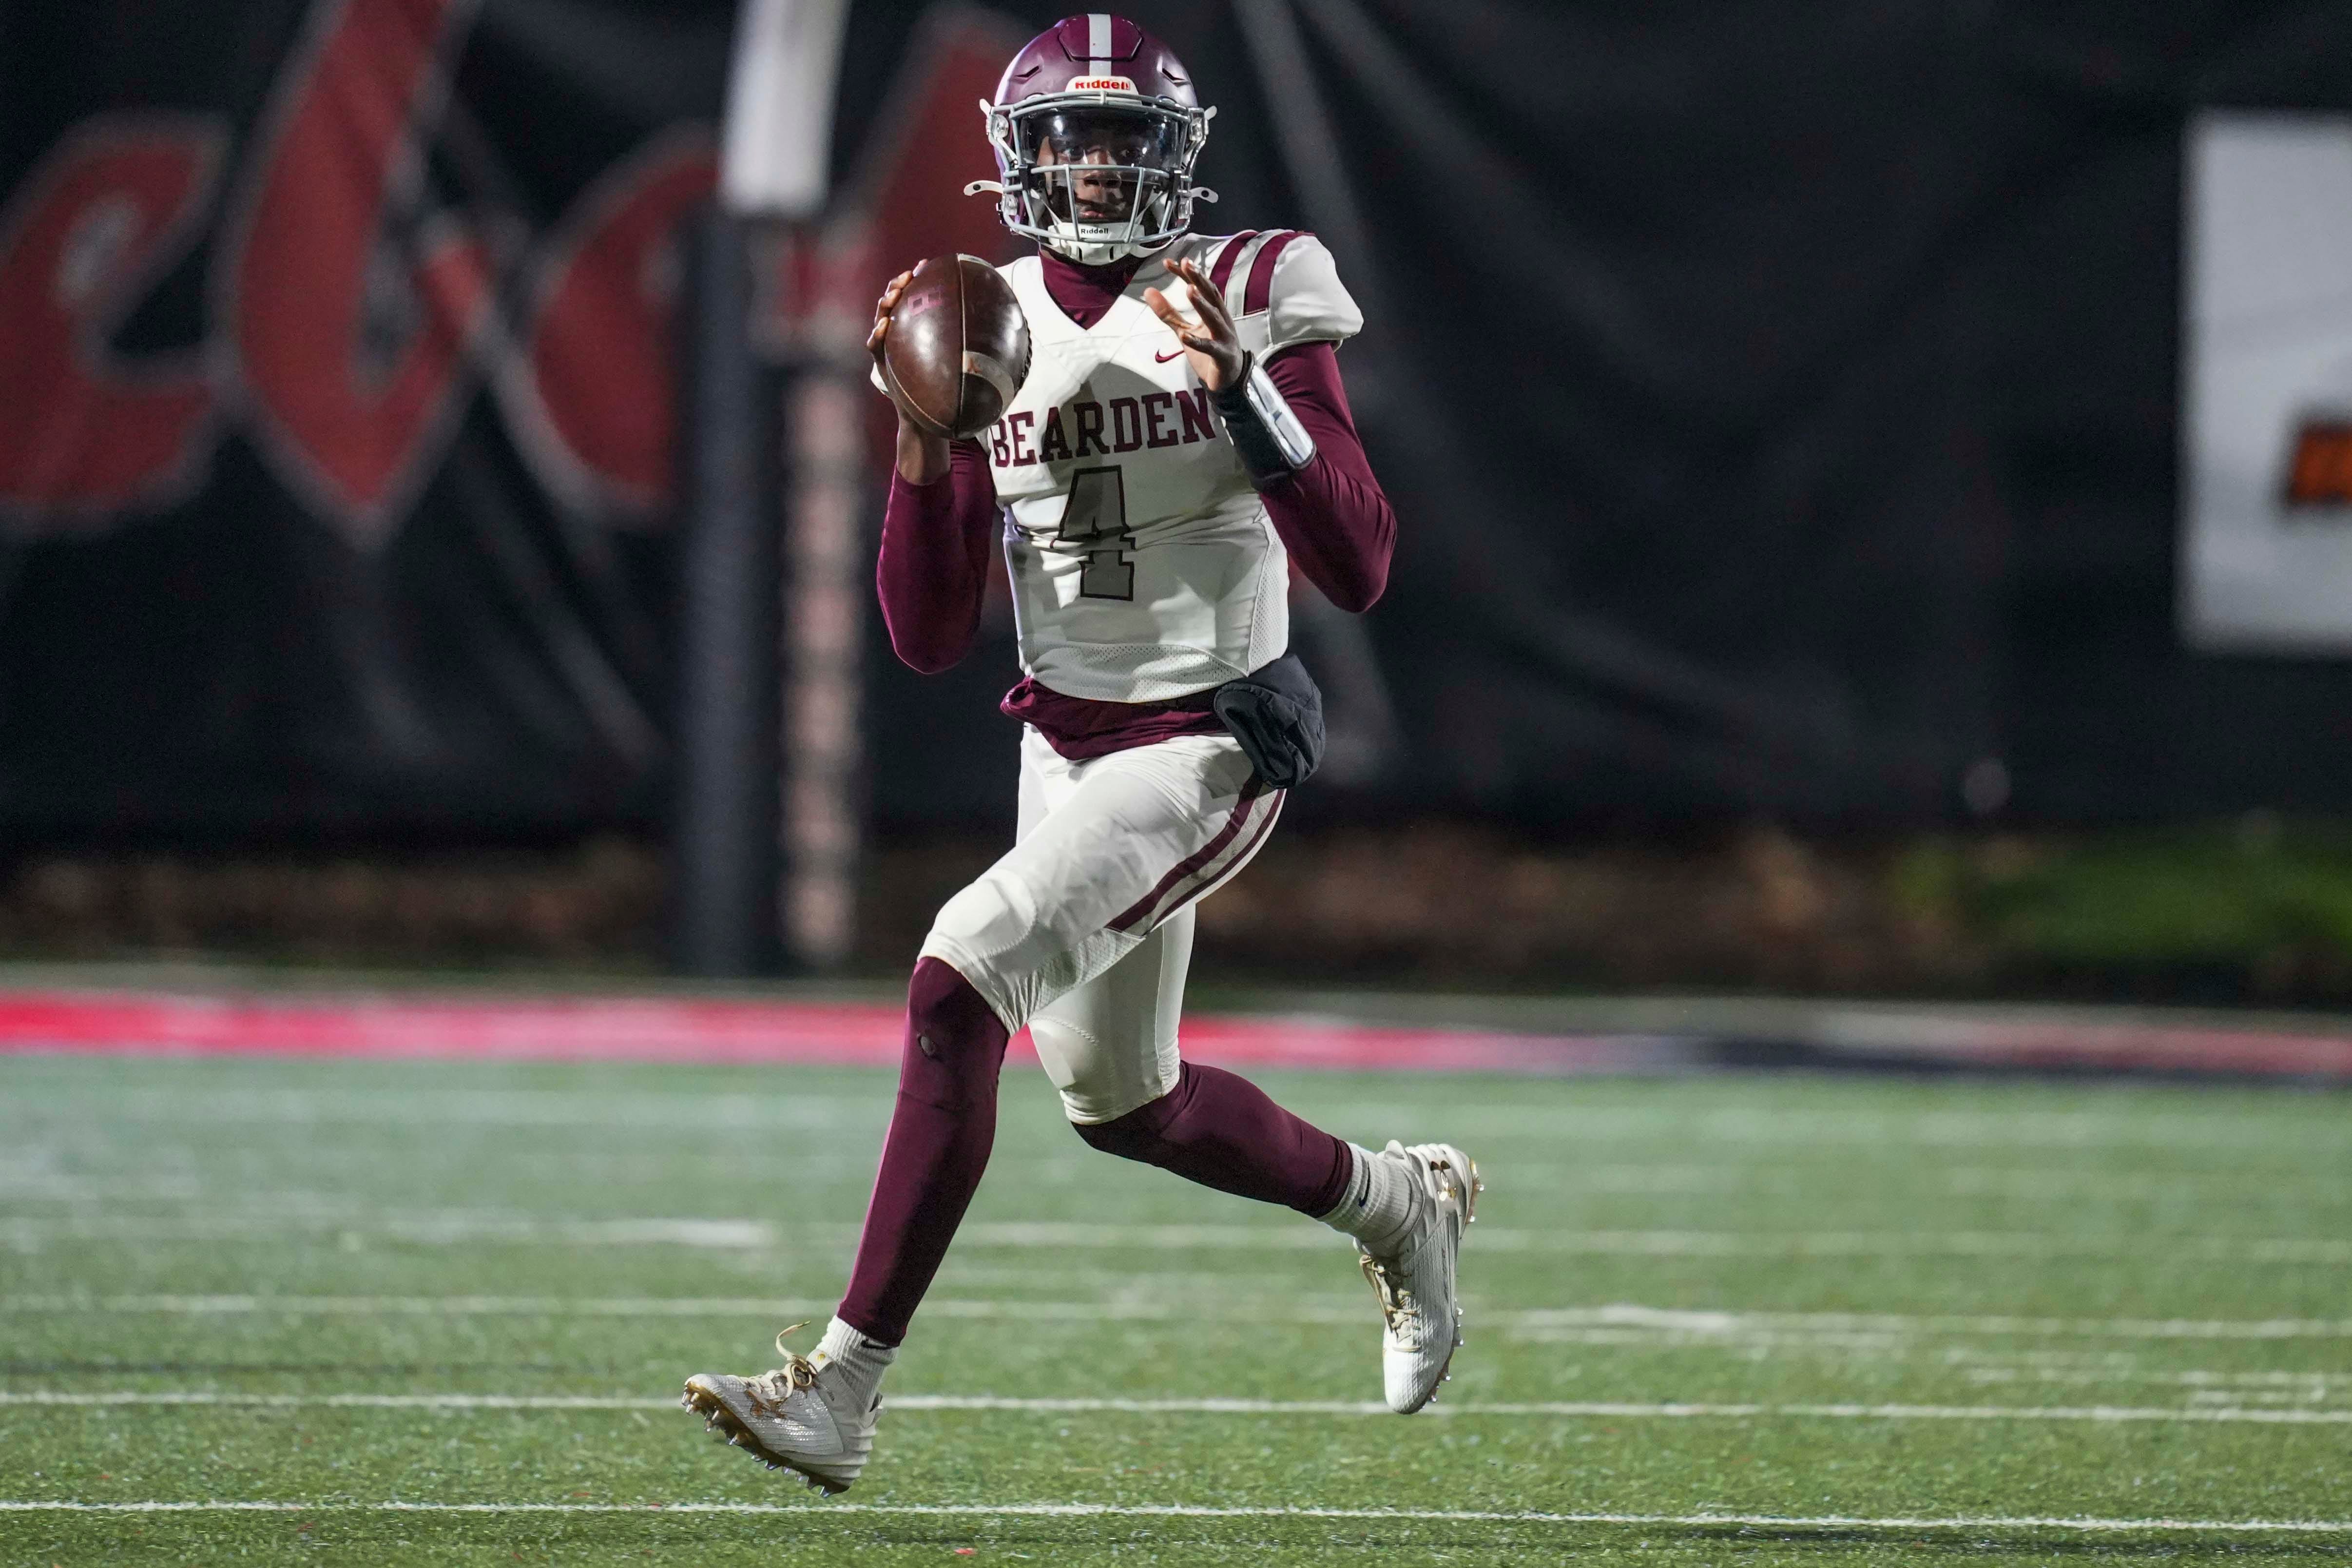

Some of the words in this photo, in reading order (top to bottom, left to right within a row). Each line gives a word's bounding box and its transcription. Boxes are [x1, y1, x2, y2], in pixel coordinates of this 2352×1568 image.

[1075, 79, 1130, 90] Riddell
[990, 388, 1216, 467] BEARDEN
[1050, 465, 1136, 601] 4
